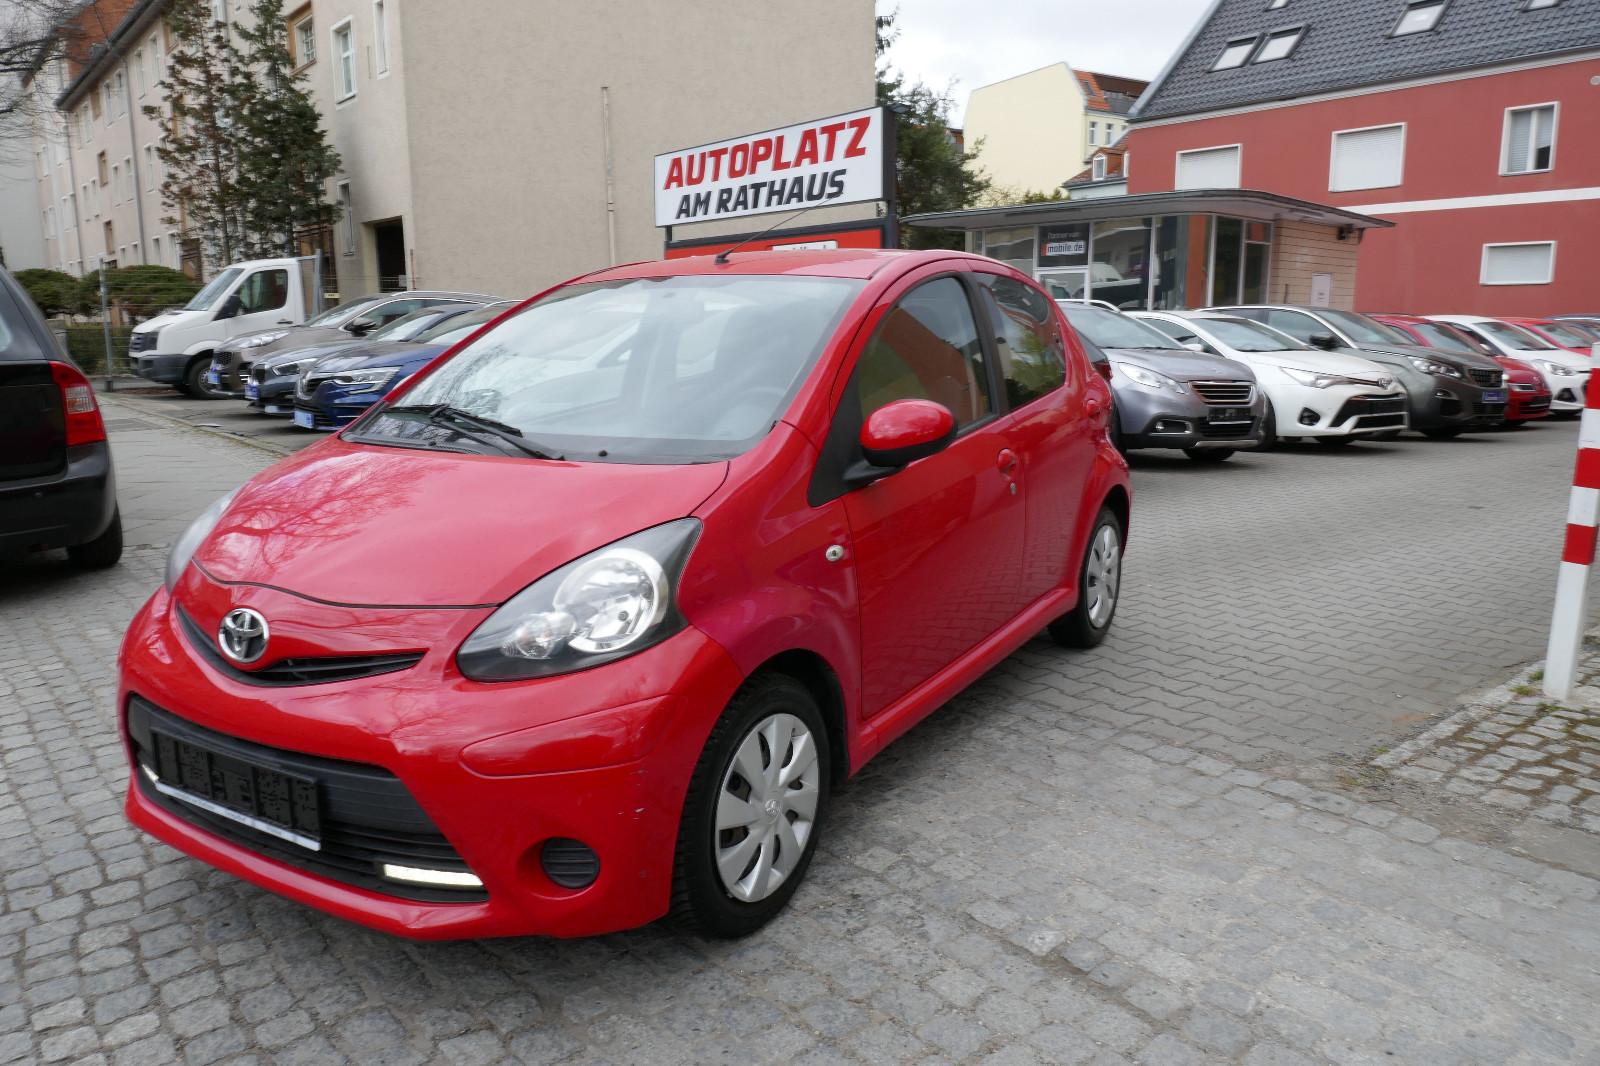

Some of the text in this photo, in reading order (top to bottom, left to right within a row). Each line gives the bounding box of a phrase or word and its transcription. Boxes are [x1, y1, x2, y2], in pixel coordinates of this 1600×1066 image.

[664, 116, 871, 190] AUTOPLATZ
[675, 169, 847, 219] AM RATHAUS
[1047, 243, 1084, 253] mobile.de
